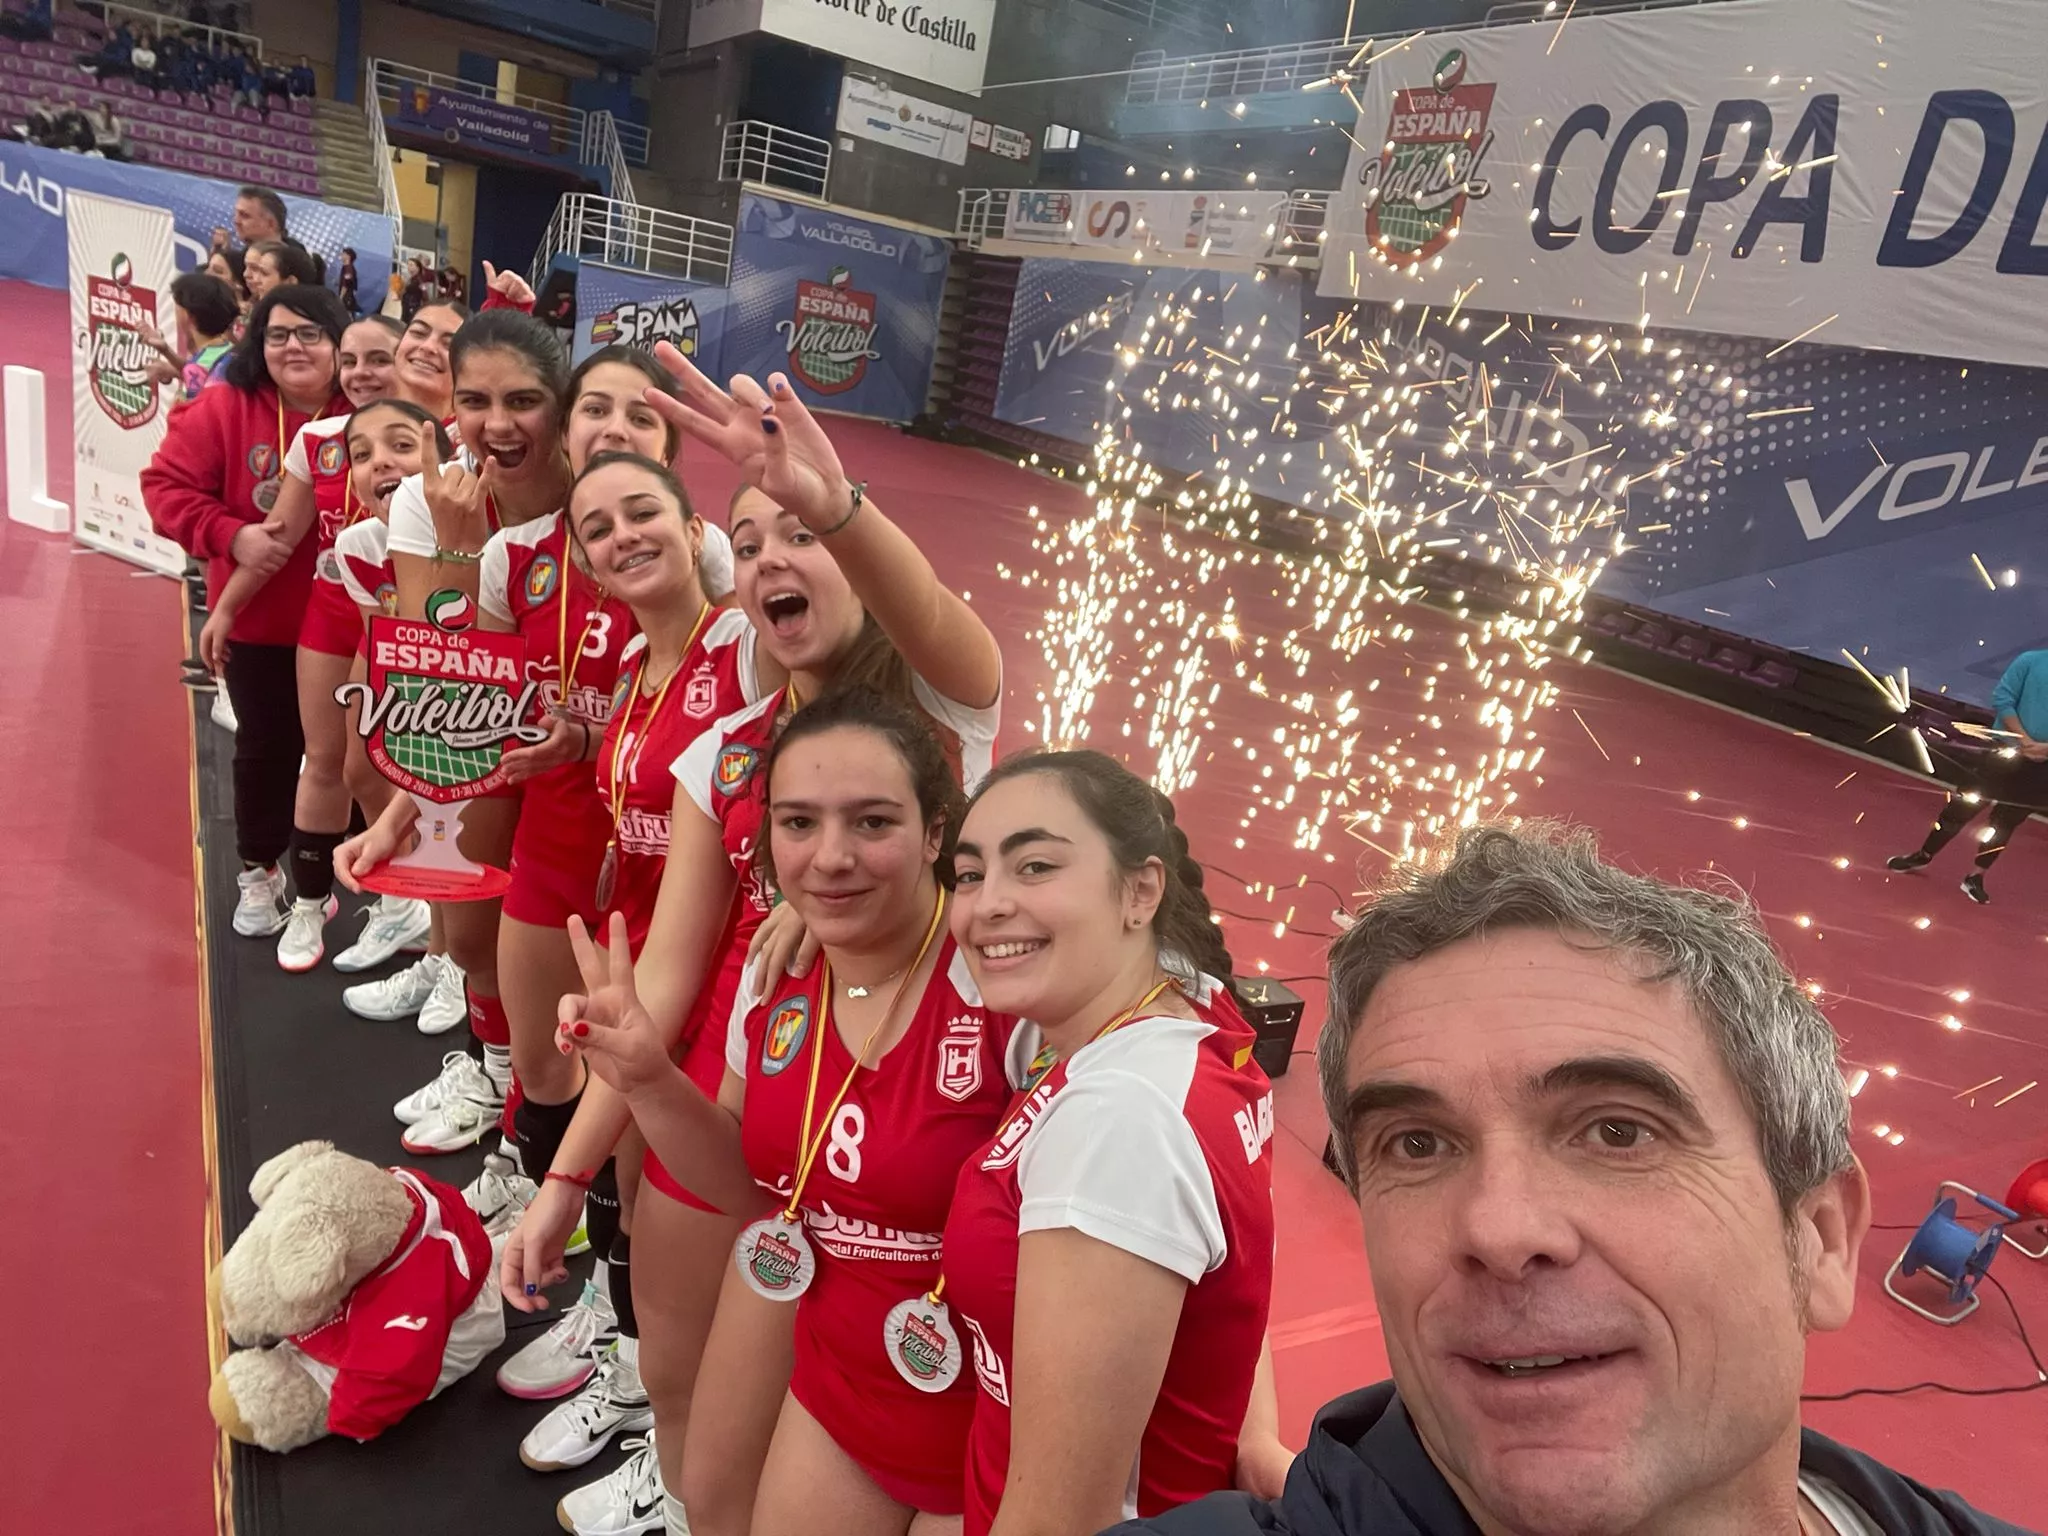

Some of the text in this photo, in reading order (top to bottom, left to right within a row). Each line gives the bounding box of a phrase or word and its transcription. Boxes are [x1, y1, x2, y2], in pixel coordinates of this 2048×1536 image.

[876, 0, 897, 26] de
[902, 6, 977, 51] Castilla
[438, 96, 550, 132] Ayuntamiento de
[1439, 93, 1455, 108] de
[456, 116, 531, 144] Valladolid
[1391, 106, 1481, 138] ESPAÑA
[1358, 130, 1495, 212] Voleibol
[1532, 94, 1840, 263] COPA
[800, 224, 897, 257] VALLADOLID
[826, 221, 875, 240] VOLEIBOL
[800, 296, 871, 323] ESPAÑA
[810, 286, 834, 300] COPA
[775, 319, 881, 363] Voleibol
[395, 625, 470, 650] COPA de
[581, 611, 613, 658] 3
[375, 640, 519, 682] ESPAÑA
[333, 683, 550, 743] Voleibol
[825, 1103, 866, 1184] 8
[590, 1191, 618, 1209] ALLSIX
[852, 1245, 929, 1263] Fruticultores
